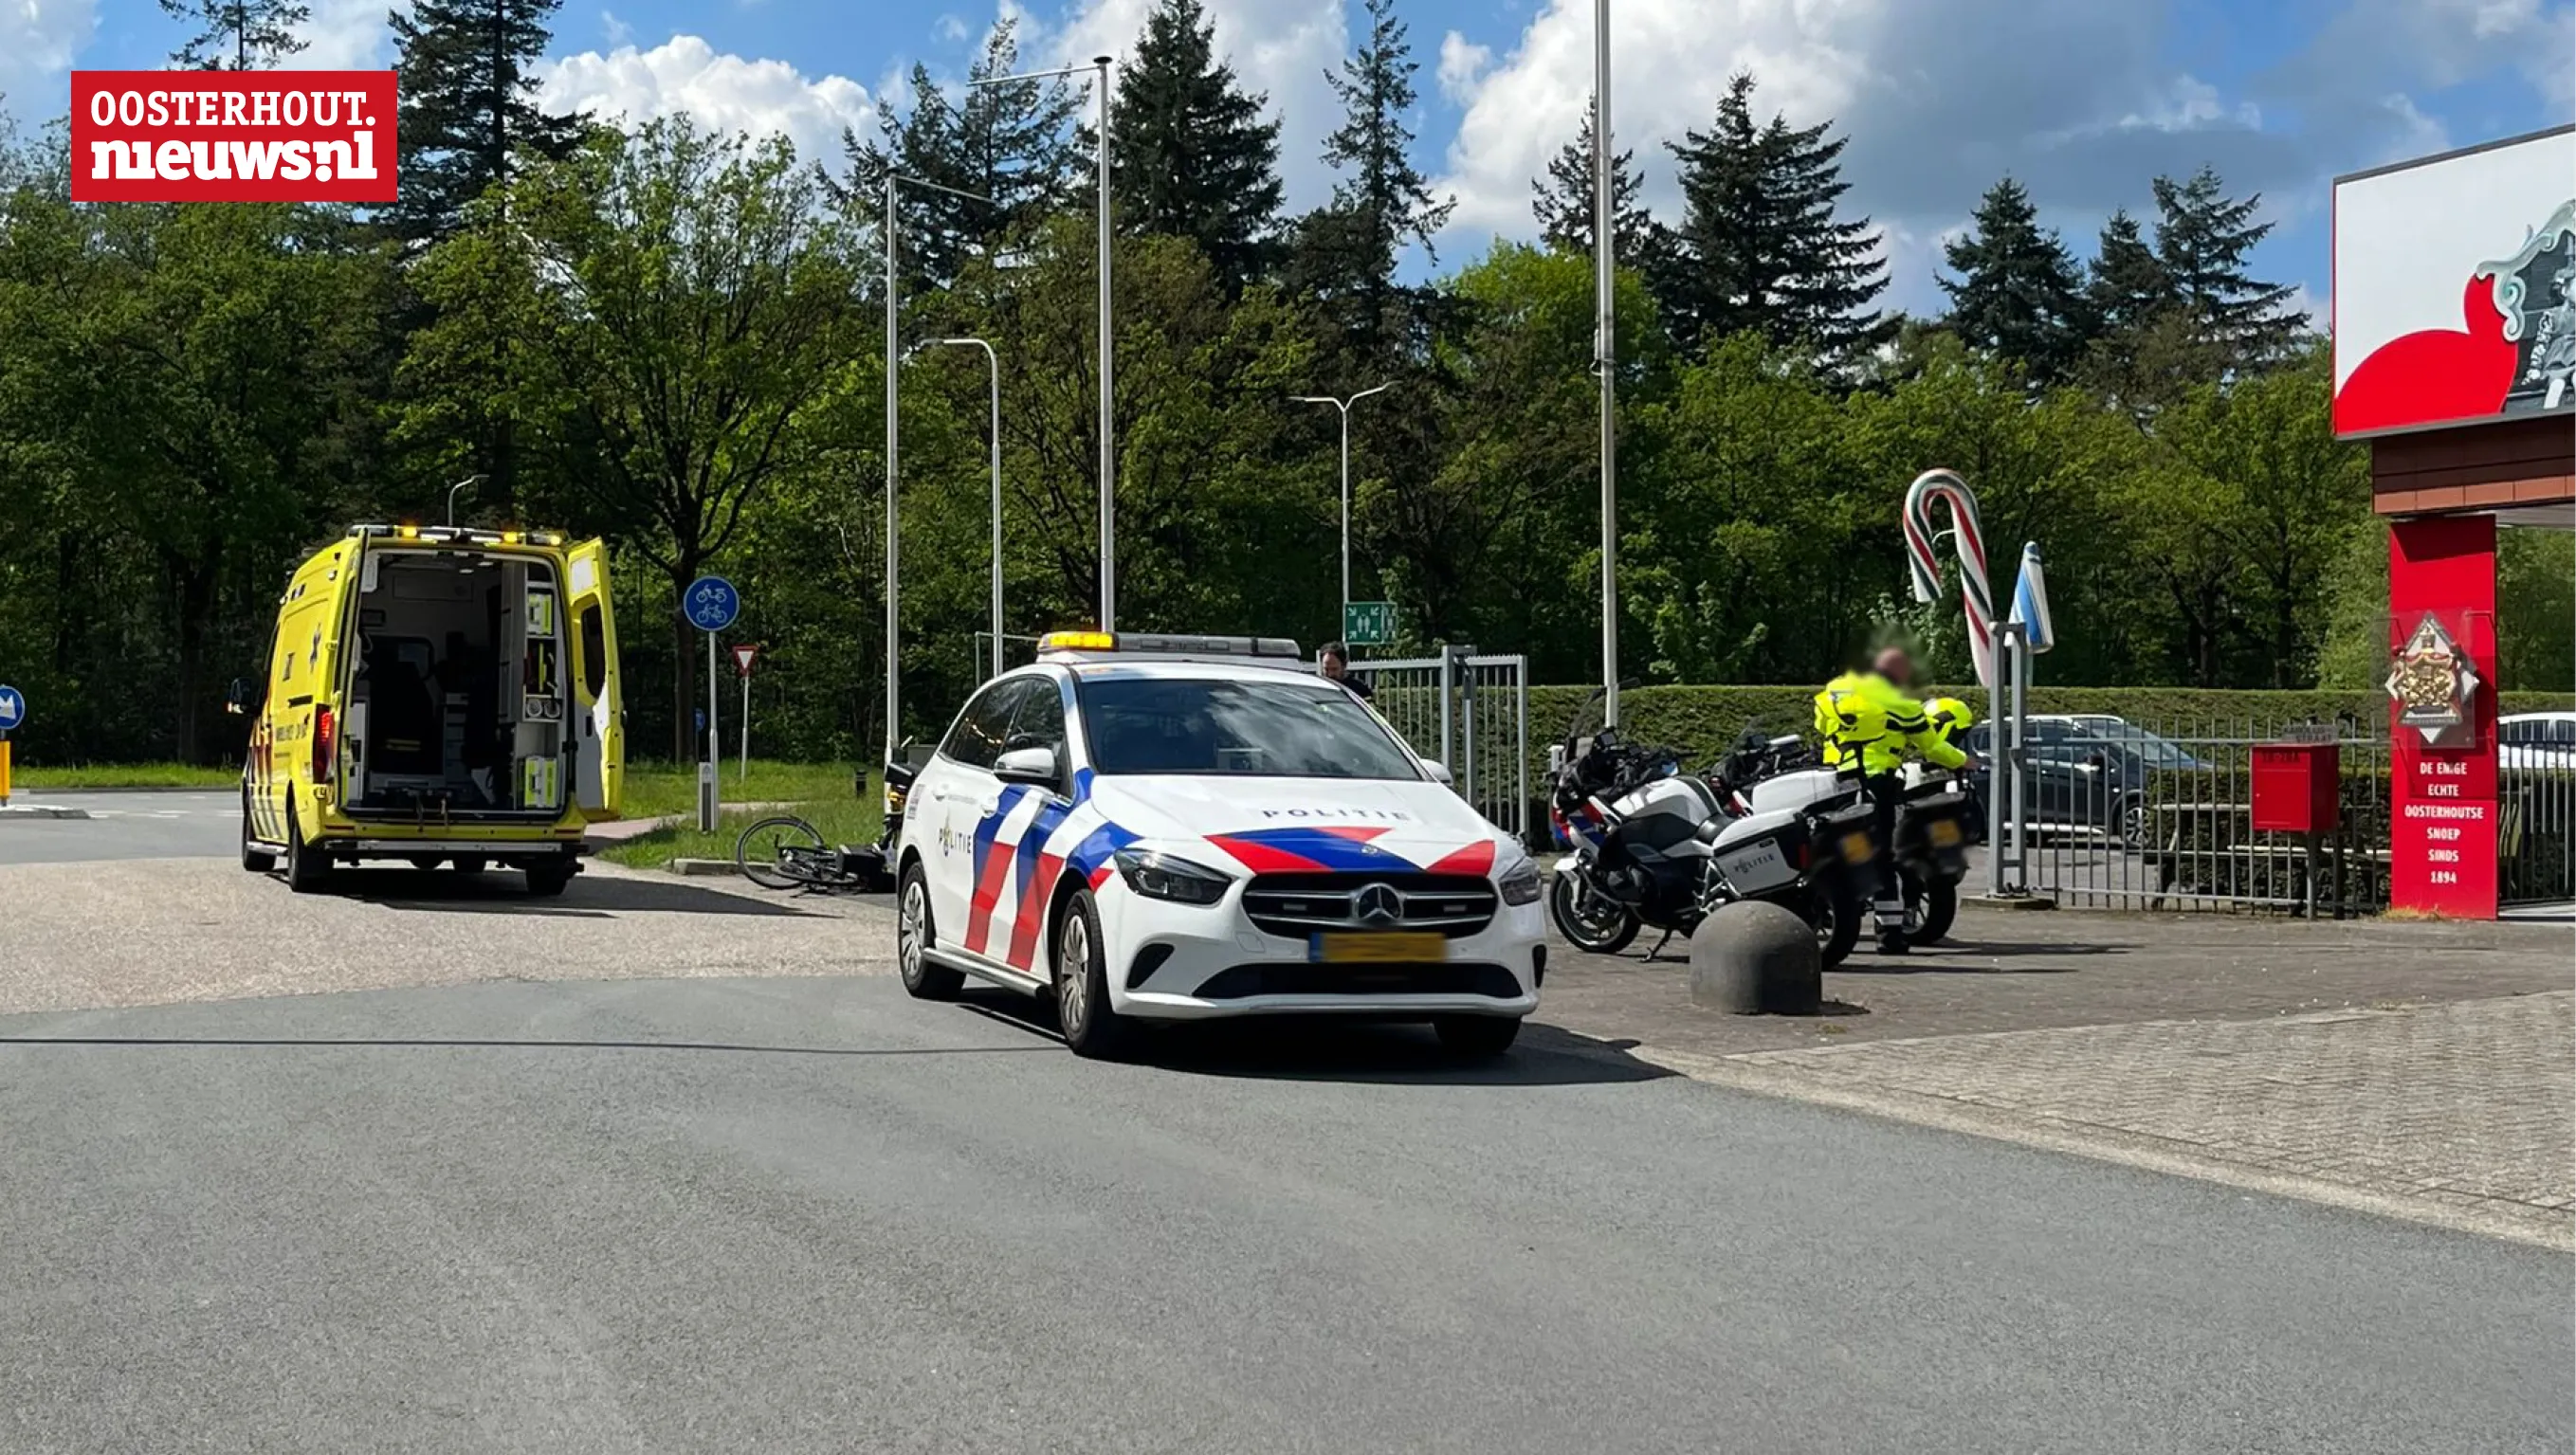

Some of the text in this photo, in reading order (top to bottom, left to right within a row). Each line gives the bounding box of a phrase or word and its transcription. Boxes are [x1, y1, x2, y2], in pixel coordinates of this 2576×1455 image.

[2420, 762, 2433, 774] DE
[2428, 784, 2459, 796] ECHTE
[1262, 808, 1411, 822] POLITIE
[2404, 804, 2485, 820] OOSTERHOUTSE
[2426, 827, 2461, 841] SNOEP
[2428, 848, 2459, 863] SINDS
[2430, 870, 2457, 883] 1894
